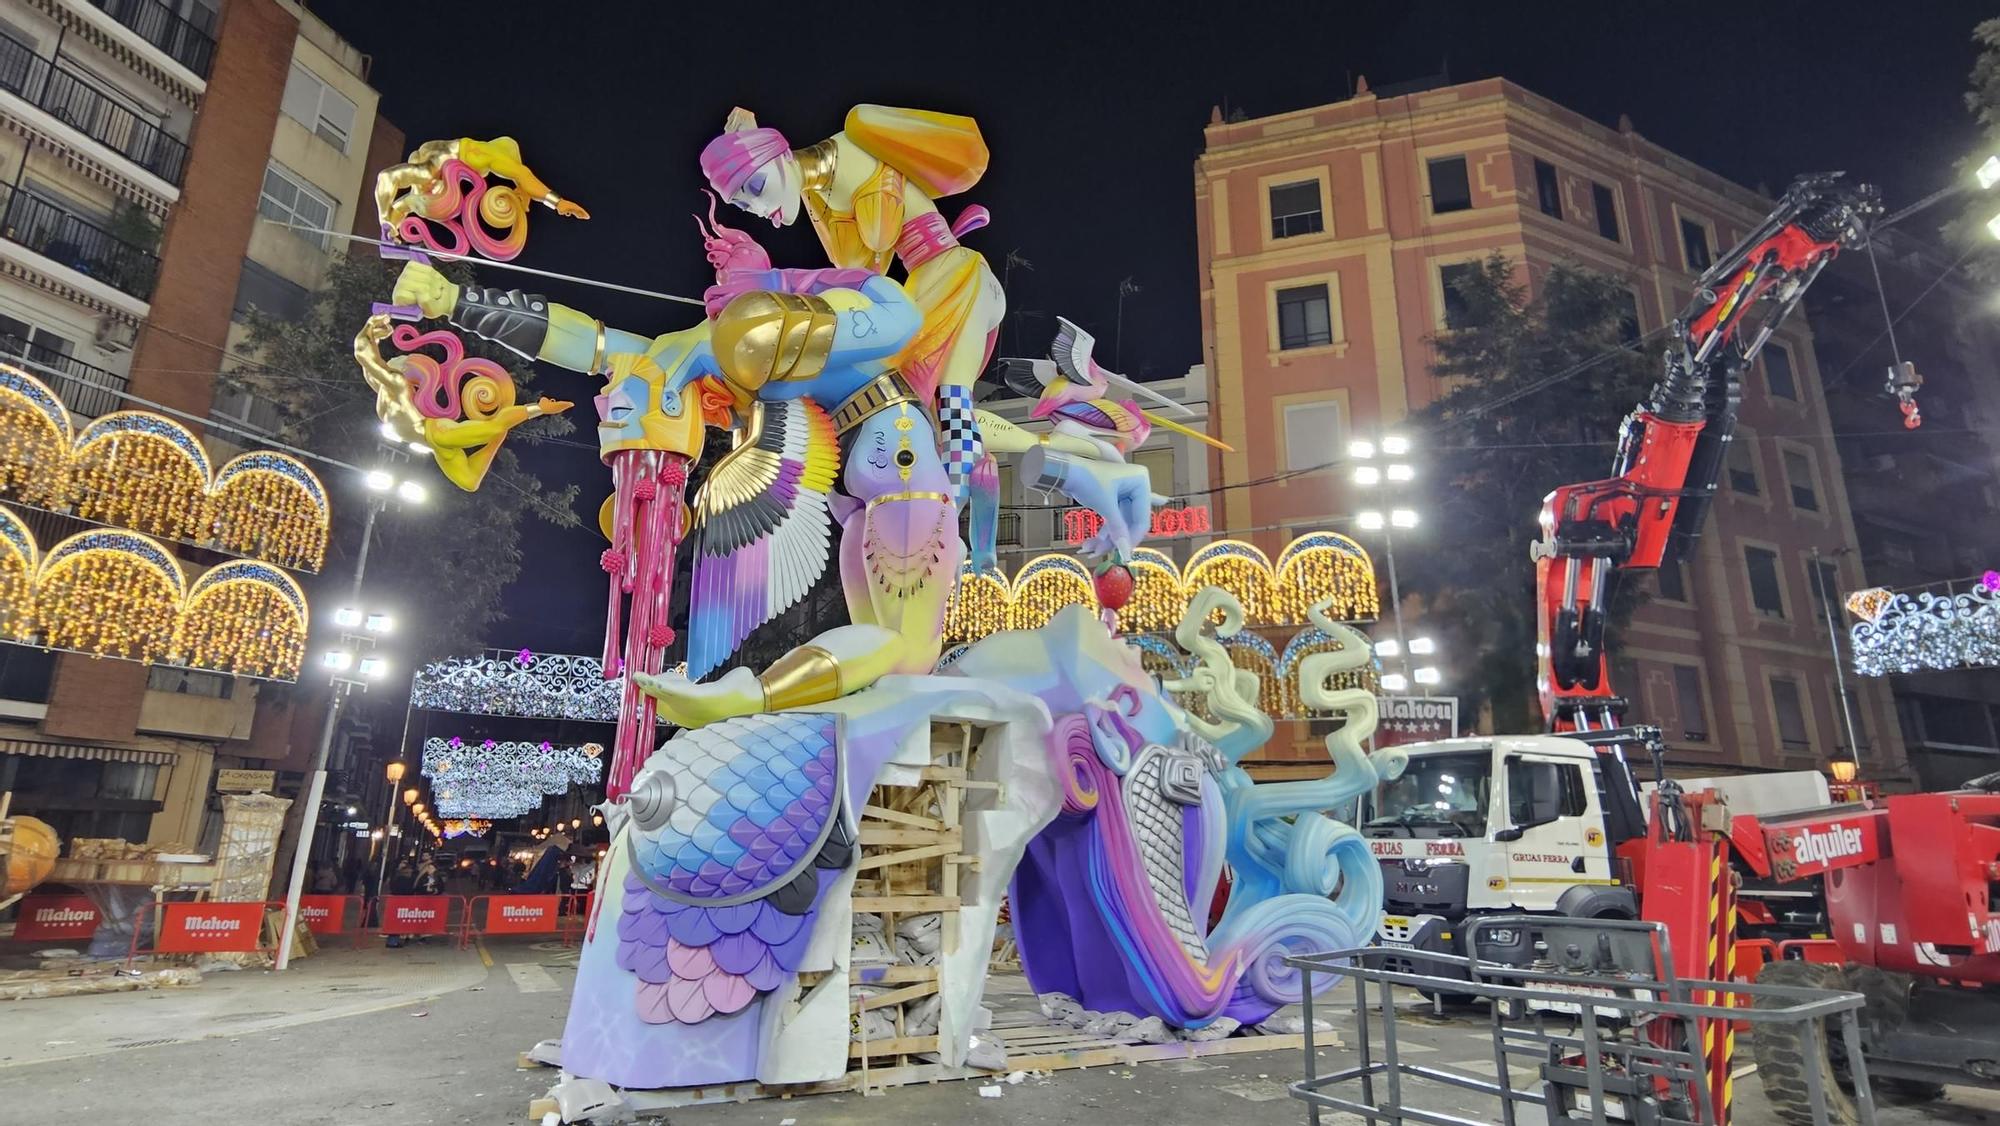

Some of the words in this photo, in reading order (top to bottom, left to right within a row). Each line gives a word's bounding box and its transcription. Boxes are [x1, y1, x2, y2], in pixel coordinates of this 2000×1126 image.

[1371, 842, 1403, 856] GRUAS
[1425, 842, 1466, 857] FERRA
[1793, 823, 1863, 868] alquiler
[1512, 853, 1541, 863] GRUAS
[1543, 855, 1570, 864] FERRA
[35, 907, 95, 922] Mahou
[397, 907, 436, 919] Mahou
[502, 905, 544, 917] Mahou
[184, 916, 241, 931] Mahou
